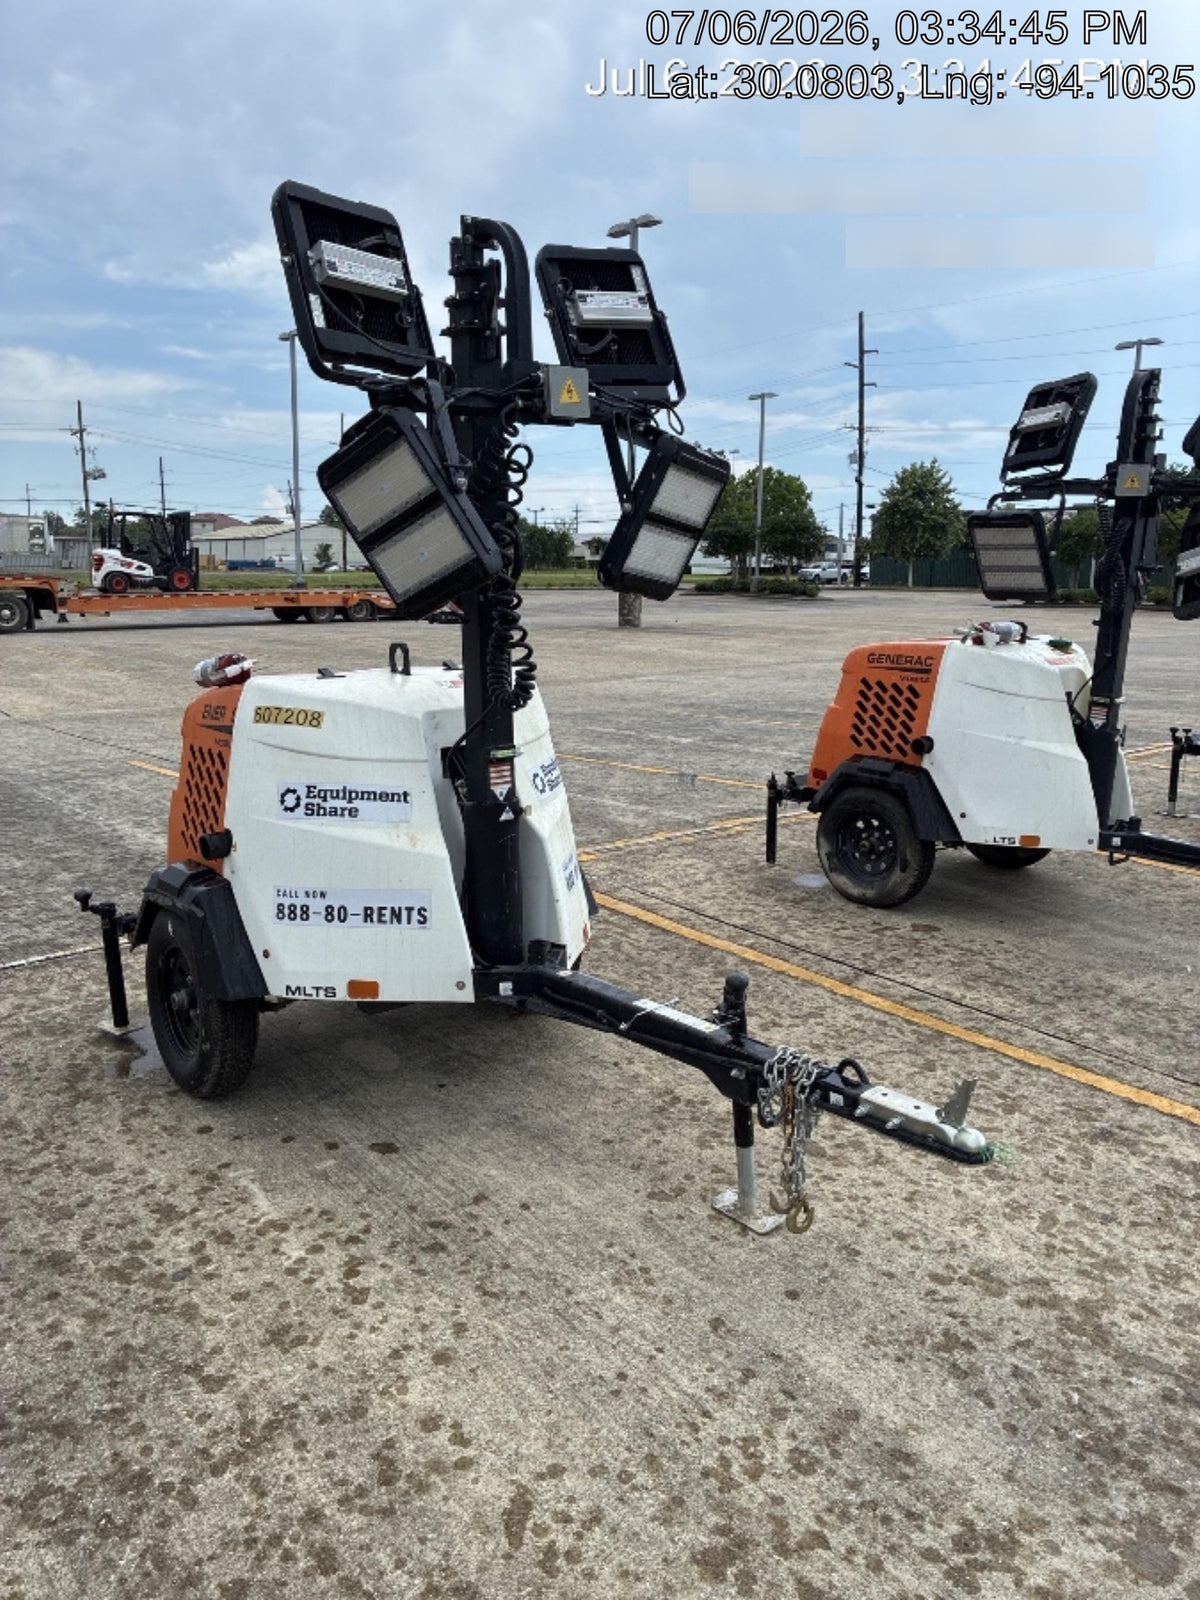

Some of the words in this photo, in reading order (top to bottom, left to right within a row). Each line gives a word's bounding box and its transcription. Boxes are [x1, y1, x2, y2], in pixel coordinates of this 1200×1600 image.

[867, 653, 934, 667] GENERAC
[253, 706, 322, 728] 607208
[304, 785, 410, 804] Equipment
[303, 802, 359, 818] Share
[276, 888, 300, 899] CALL
[305, 890, 327, 900] NOW
[276, 903, 428, 925] 888-80-RENTS
[285, 984, 337, 998] MLTS
